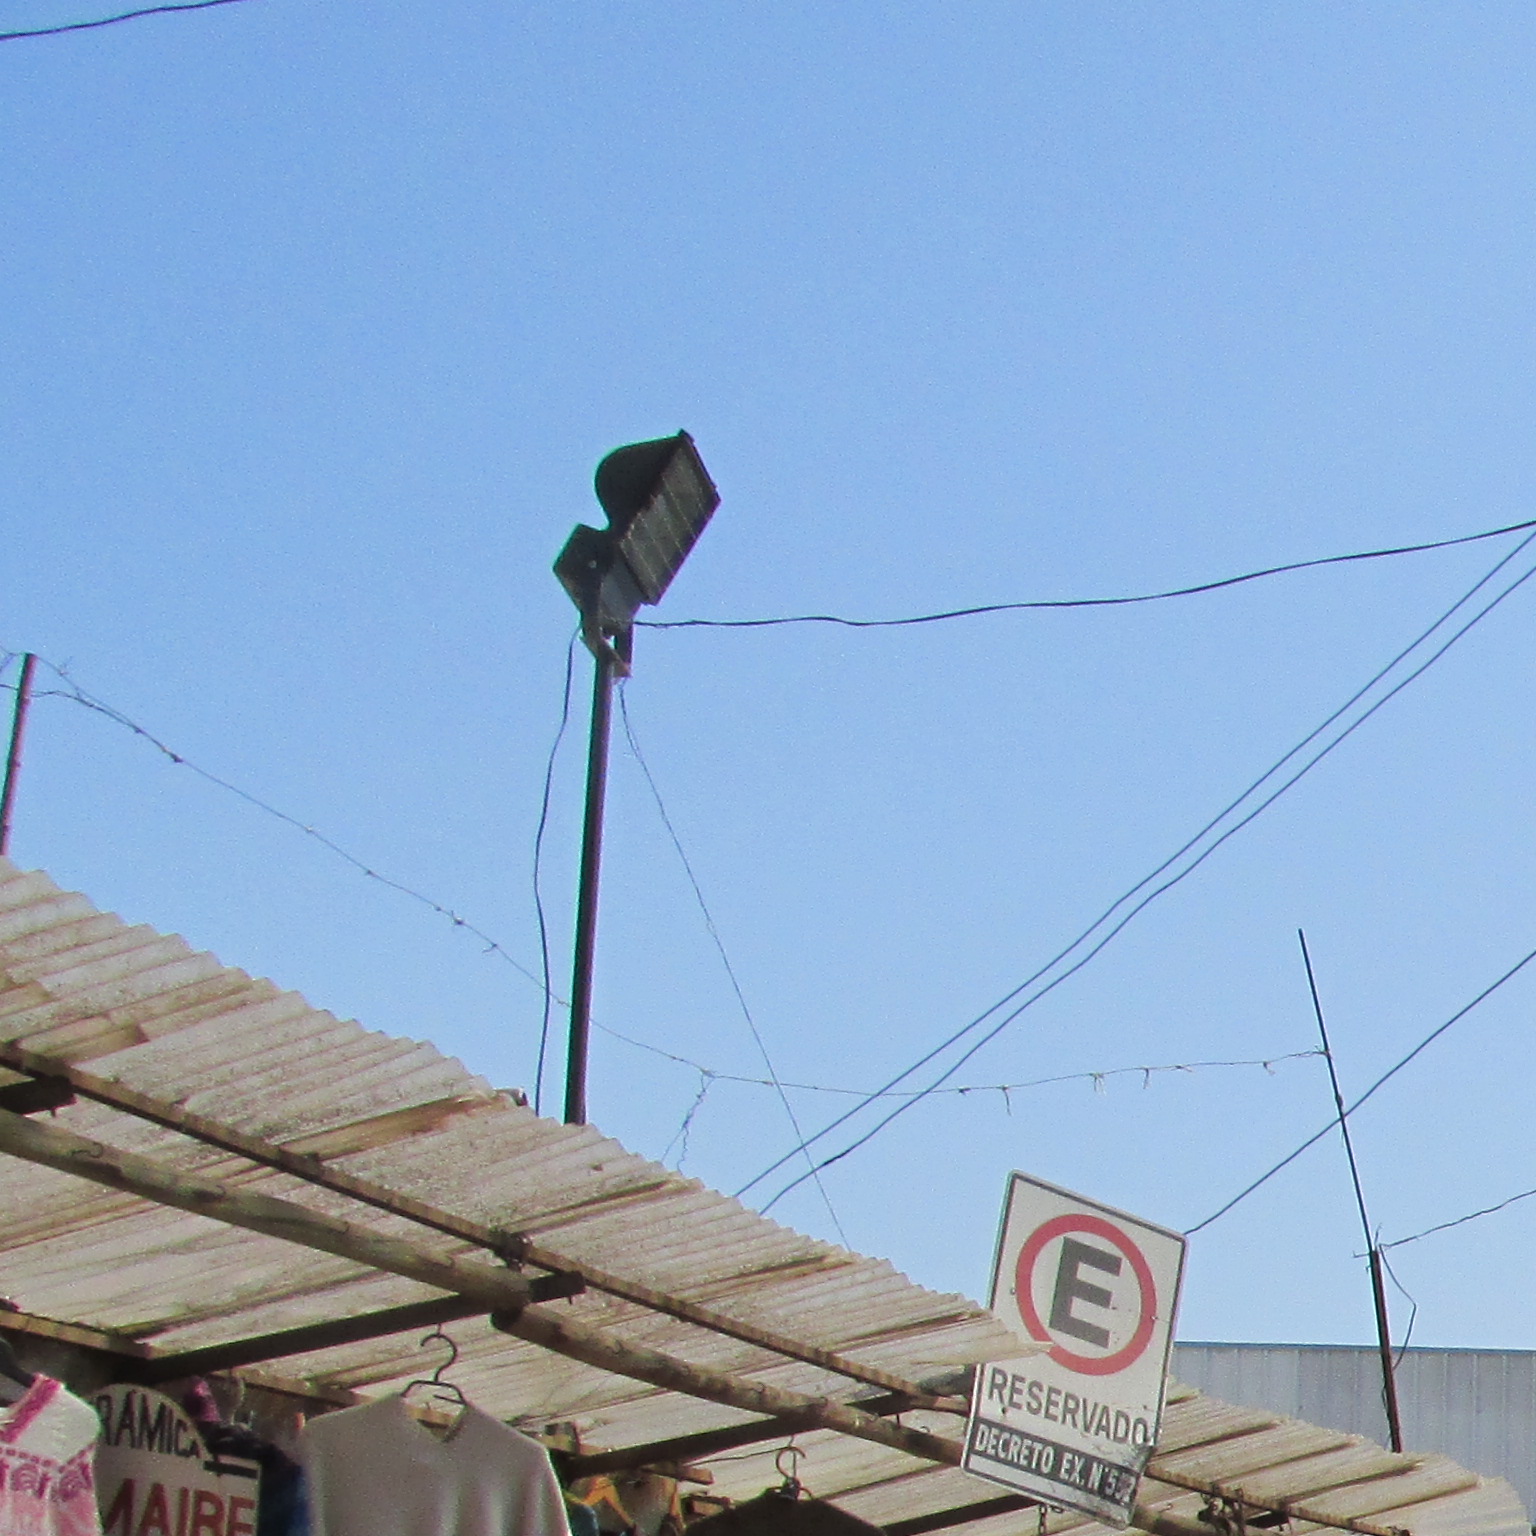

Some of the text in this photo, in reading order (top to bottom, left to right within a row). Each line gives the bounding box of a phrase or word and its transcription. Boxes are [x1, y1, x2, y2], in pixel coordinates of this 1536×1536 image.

[1048, 1235, 1123, 1350] E
[95, 1388, 202, 1460] RAMICA
[987, 1366, 1151, 1447] RESERVADO
[974, 1423, 1055, 1475] DECRETO
